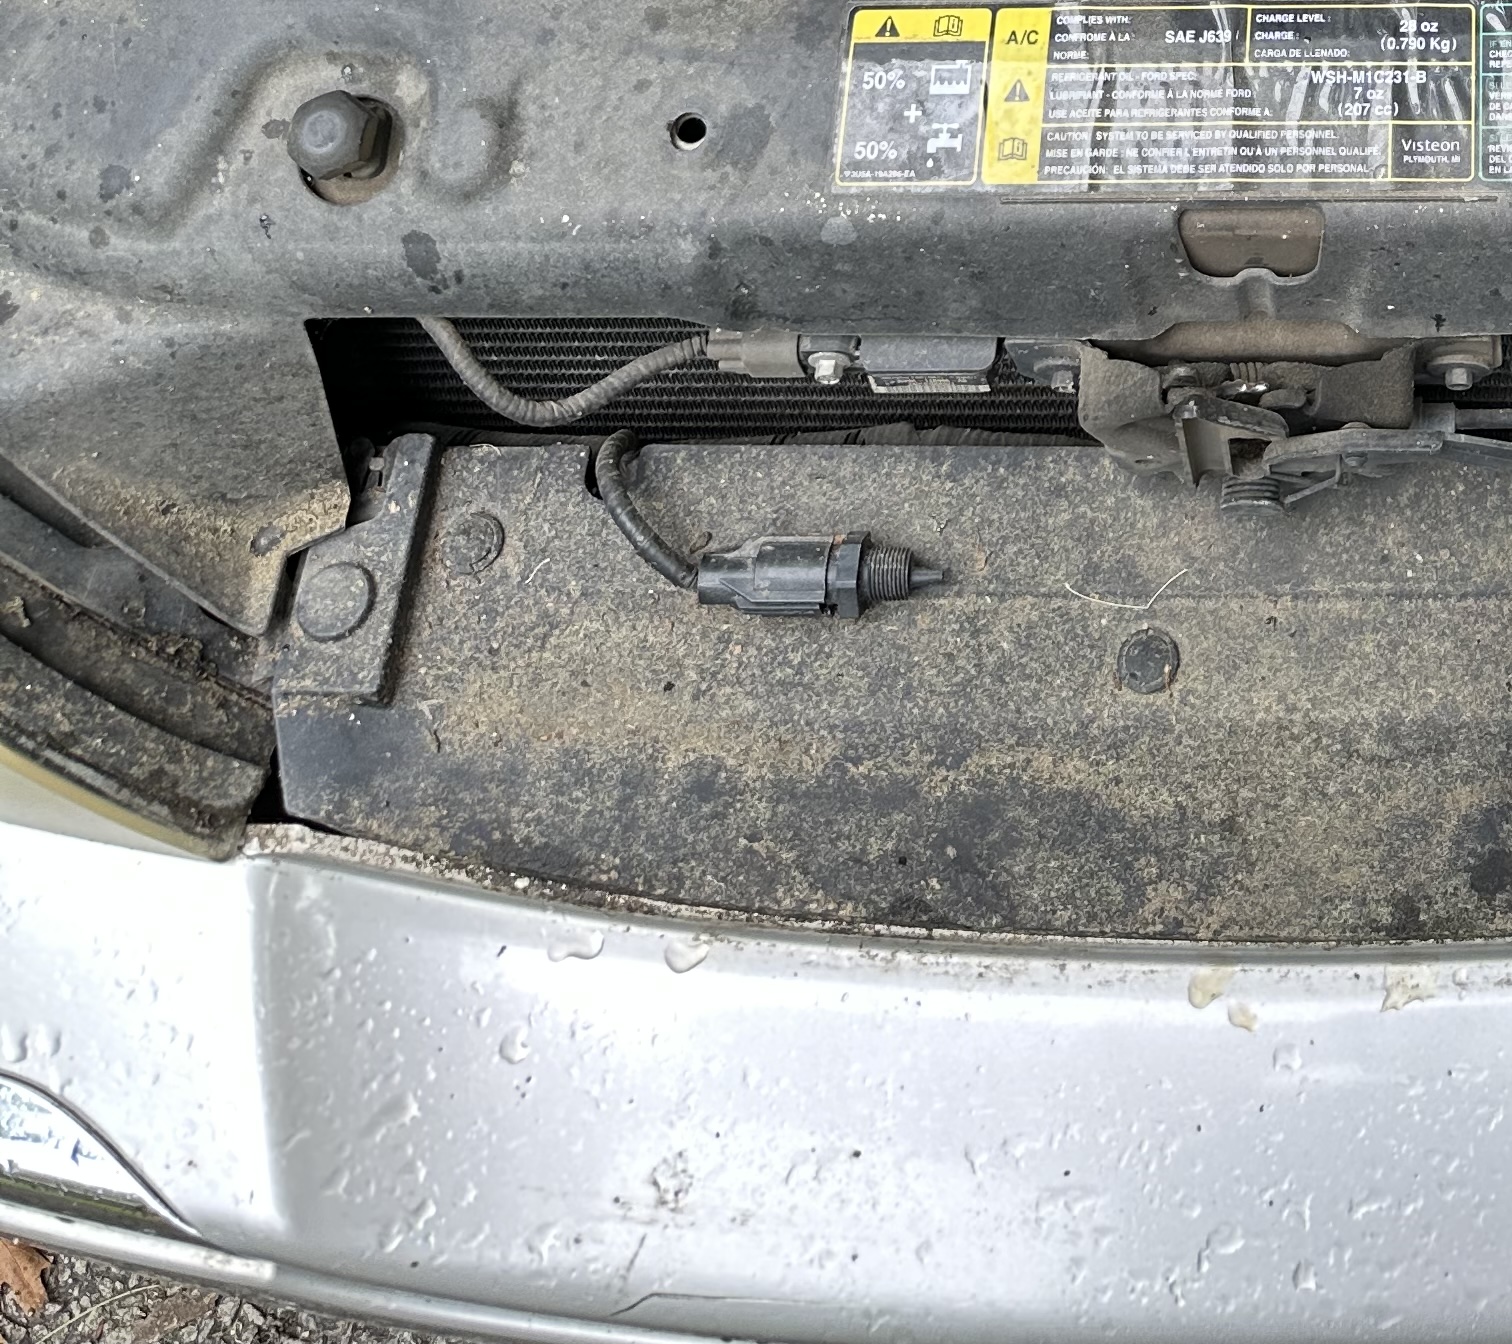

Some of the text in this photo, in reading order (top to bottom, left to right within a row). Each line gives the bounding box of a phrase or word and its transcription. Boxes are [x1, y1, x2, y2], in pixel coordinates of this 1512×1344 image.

[1056, 15, 1103, 25] COMPLIES
[1255, 14, 1296, 23] CHARGE
[1399, 19, 1439, 33] 28 oz
[1006, 30, 1039, 46] A/C
[1108, 30, 1116, 42] À
[1164, 29, 1232, 44] SAE J639
[1380, 37, 1457, 53] (0.790 Kg)
[1489, 40, 1497, 48] IF
[1254, 48, 1289, 58] CARGA
[1289, 48, 1302, 57] DE
[862, 70, 906, 90] 50%
[1051, 71, 1118, 82] REFRIGERANT
[1119, 72, 1134, 81] OIL
[1141, 71, 1168, 81] FORD
[1310, 69, 1427, 84] WSH-M1C231-B
[1489, 81, 1498, 90] SI
[1049, 87, 1252, 100] LUBRIFIANT CONFORME À LA NORME FORD
[1353, 86, 1385, 100] 7 oz
[1048, 109, 1069, 119] USE
[1070, 108, 1102, 118] ACEITE
[1104, 108, 1129, 118] PARA
[1129, 107, 1208, 118] REFRIGERANTES
[1209, 107, 1262, 117] CONFORME
[1337, 102, 1400, 117] (207 cc)
[1489, 103, 1501, 111] DE
[1095, 131, 1134, 141] SYSTEM
[1135, 131, 1149, 141] TO
[1150, 130, 1164, 140] BE
[1165, 130, 1213, 140] SERVICED
[1214, 130, 1227, 140] BY
[1228, 129, 1278, 140] QUALIFIED
[1489, 134, 1499, 143] SI
[854, 140, 898, 160] 50%
[1045, 149, 1068, 158] MISE
[1070, 148, 1084, 158] EN
[1085, 148, 1119, 158] GARDE
[1125, 148, 1139, 157] NE
[1141, 147, 1182, 158] CONFIER
[1239, 145, 1263, 156] QU'À
[1264, 147, 1278, 156] UN
[1280, 147, 1337, 156] PERSONNEL
[1401, 139, 1460, 152] Visteon
[1451, 154, 1461, 163] MI
[1489, 155, 1508, 164] DEL
[1113, 165, 1125, 174] EL
[1127, 164, 1168, 174] SISTEMA
[1169, 164, 1196, 174] DEBE
[1197, 164, 1216, 174] SER
[1217, 163, 1266, 173] ATENDIDO
[1267, 163, 1294, 173] SOLO
[1295, 163, 1316, 173] POR
[1318, 163, 1370, 173] PERSONAL
[1489, 165, 1501, 174] EN
